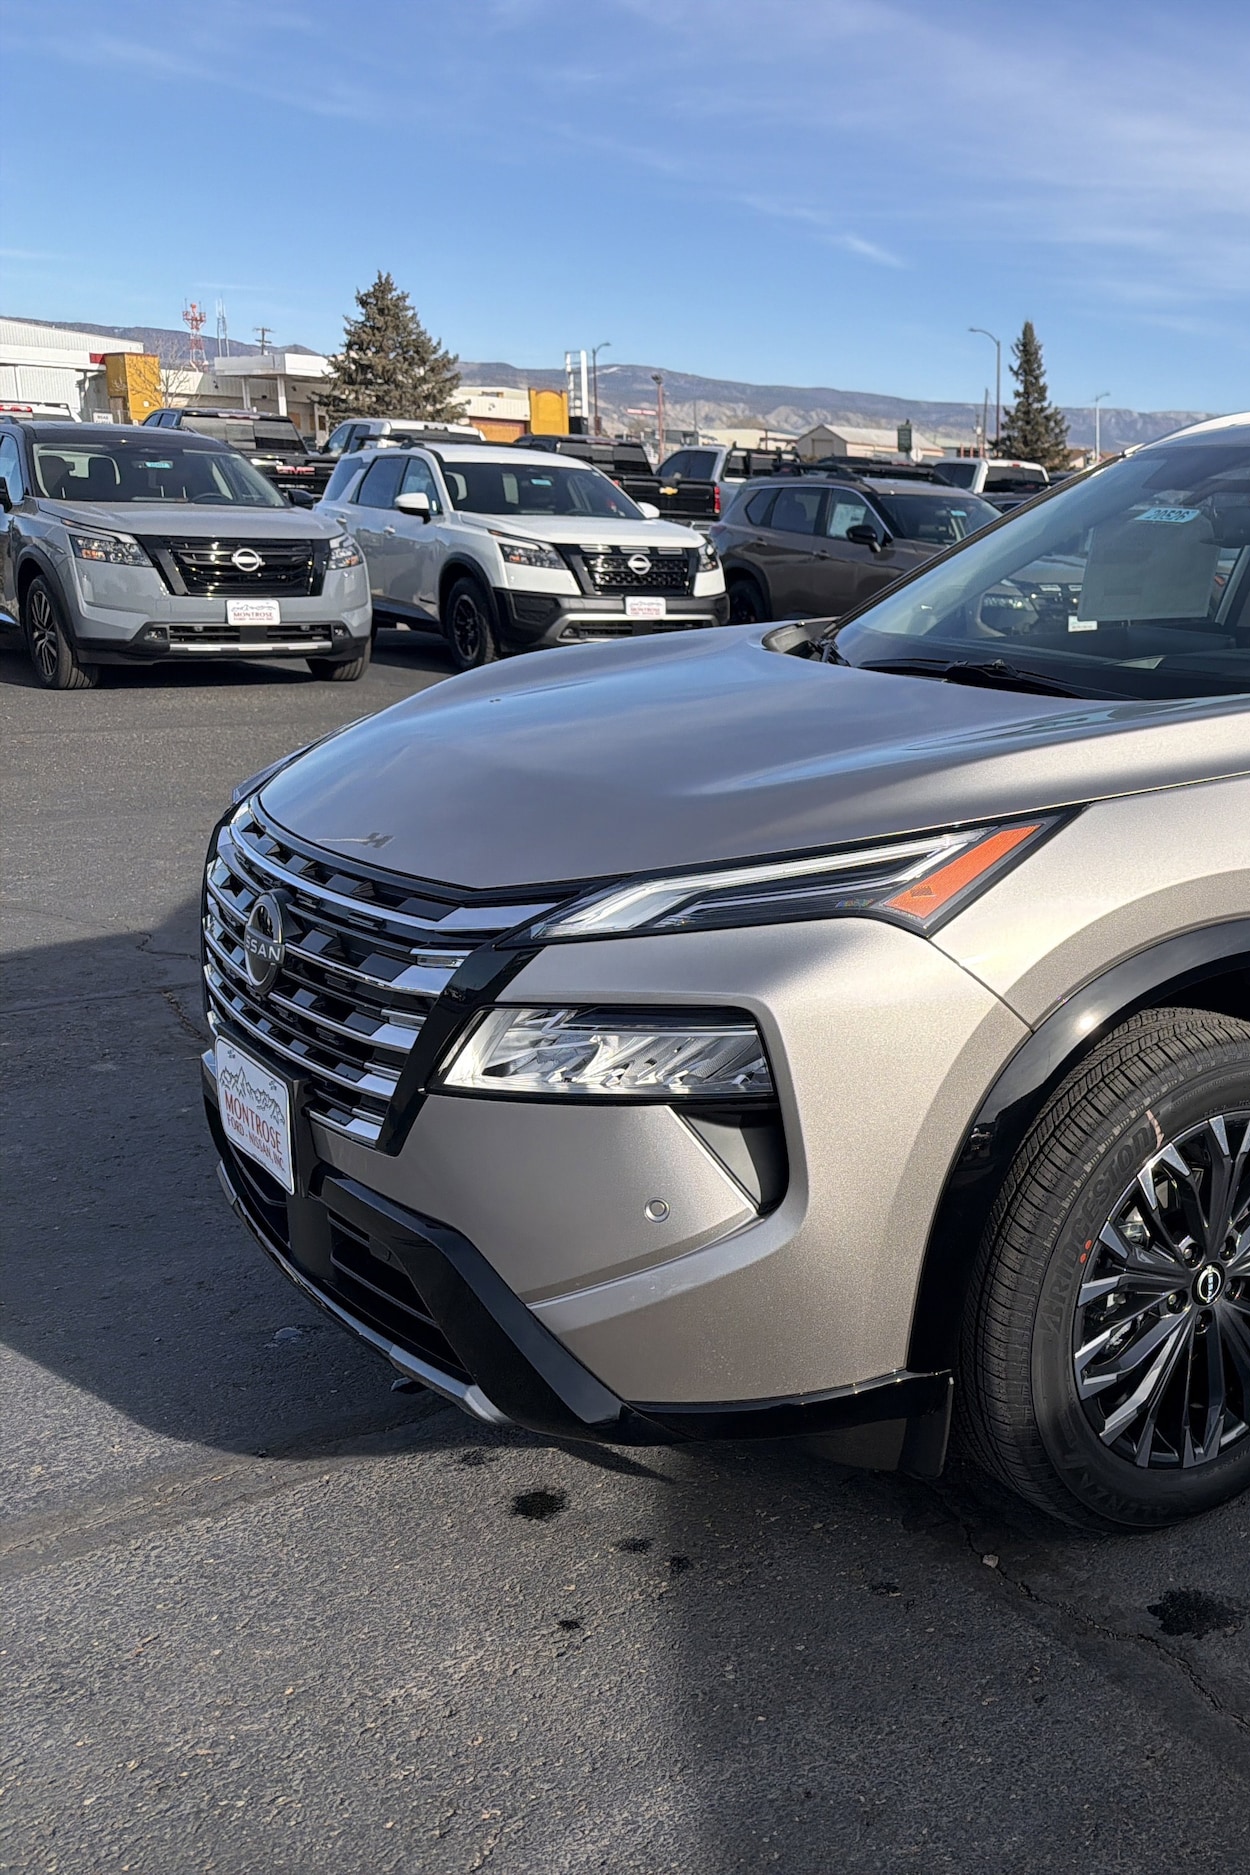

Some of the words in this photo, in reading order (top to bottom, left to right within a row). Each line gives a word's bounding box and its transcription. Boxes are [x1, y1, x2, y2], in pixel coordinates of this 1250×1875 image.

[244, 933, 280, 961] SSAN
[224, 1089, 283, 1155] MONTROSE
[226, 1112, 245, 1137] FORD
[248, 1132, 273, 1164] NISSAN,
